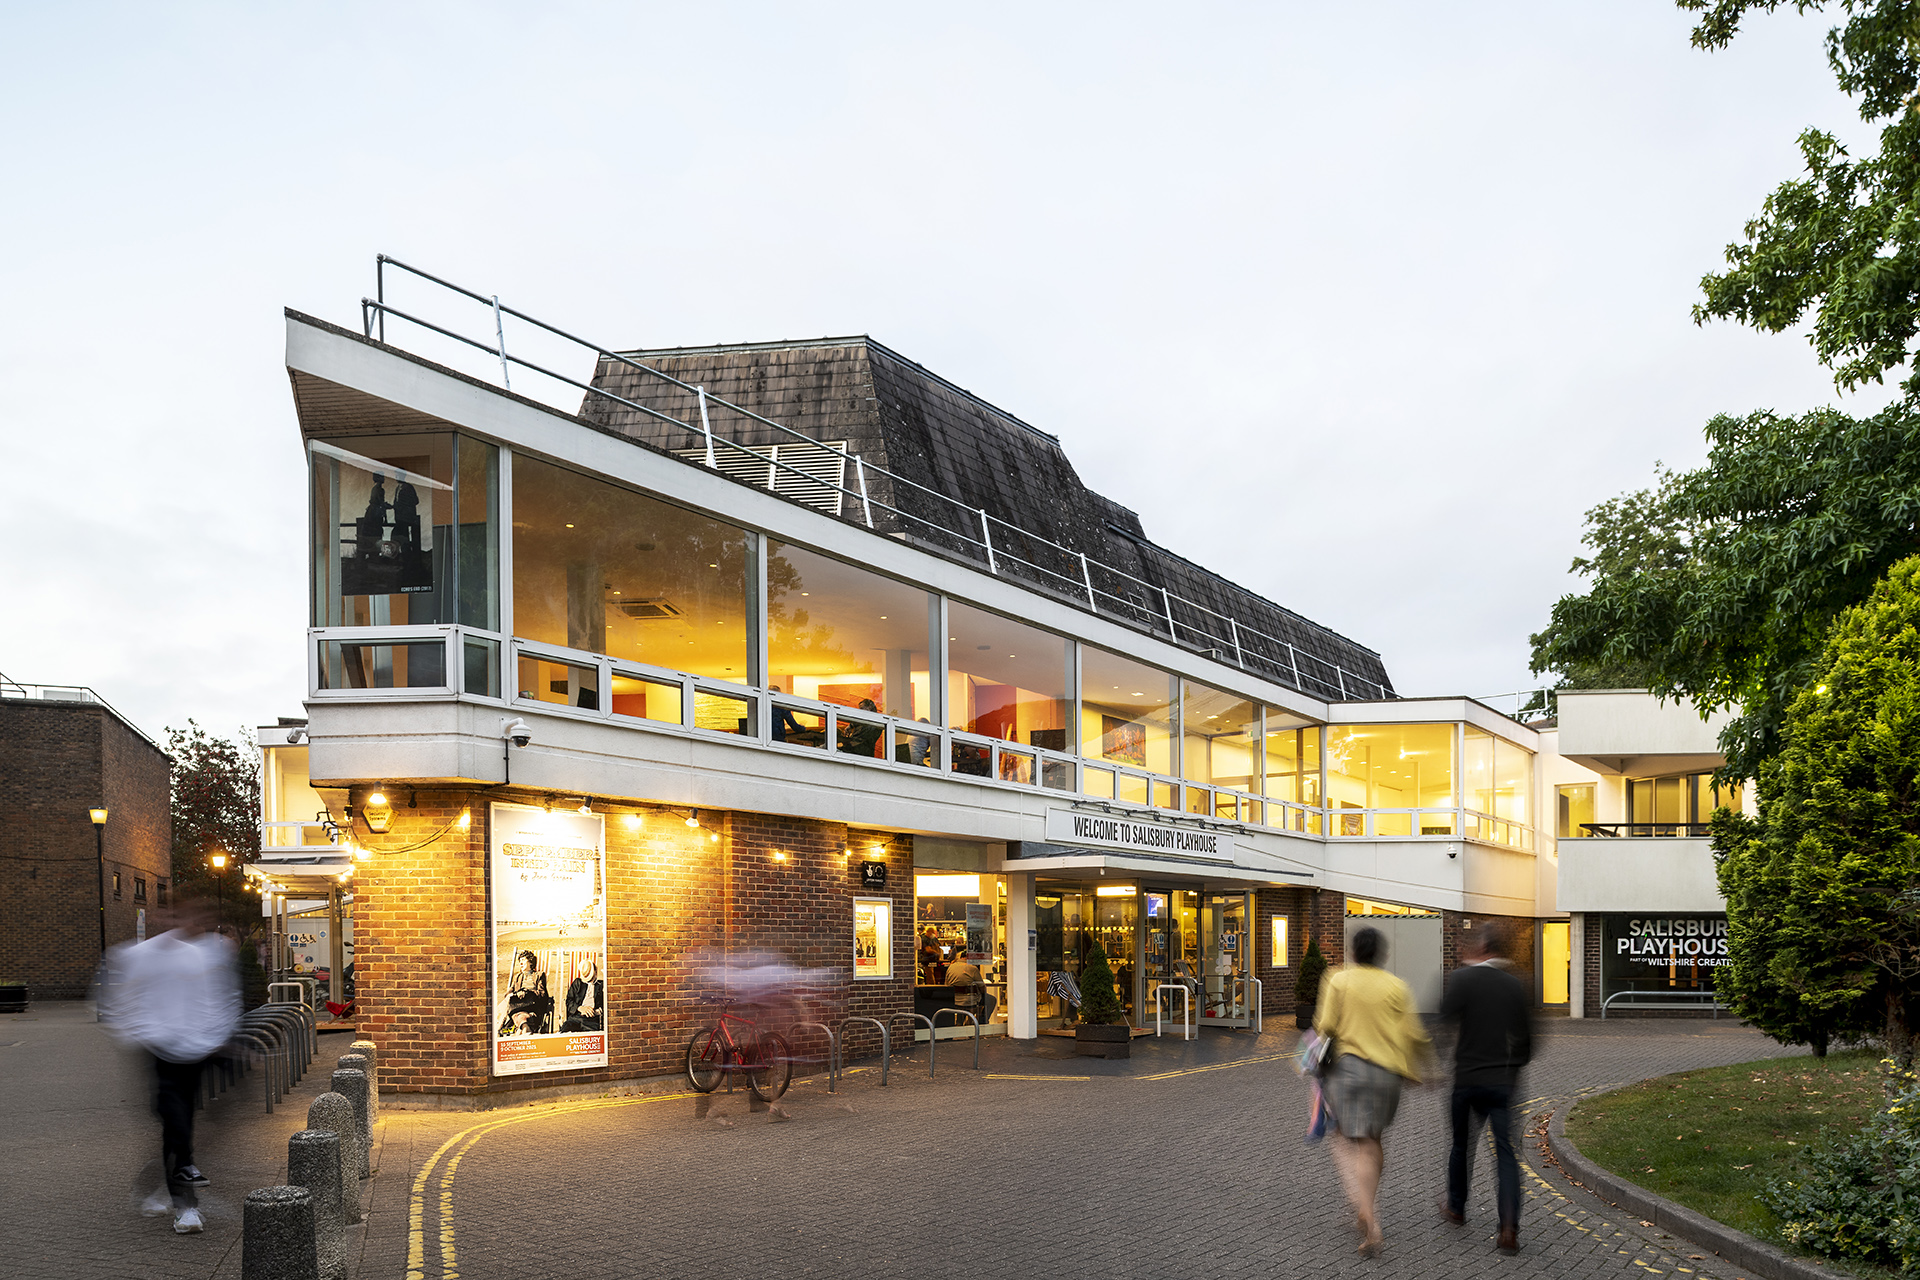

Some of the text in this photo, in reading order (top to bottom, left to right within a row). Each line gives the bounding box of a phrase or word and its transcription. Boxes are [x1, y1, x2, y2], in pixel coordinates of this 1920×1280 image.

[1074, 816, 1217, 853] WELCOME TO SALISBURY PLAYHOUSE
[502, 843, 594, 860] SEPTEMBER
[510, 858, 524, 869] IN
[1629, 919, 1729, 936] SALISBUR
[1617, 938, 1729, 955] PLAYHOUS
[1648, 958, 1695, 966] WILTSHIRE
[1697, 958, 1734, 966] CREATI
[566, 1043, 601, 1051] PLAYHOUSE
[569, 1037, 601, 1045] SALISBURY
